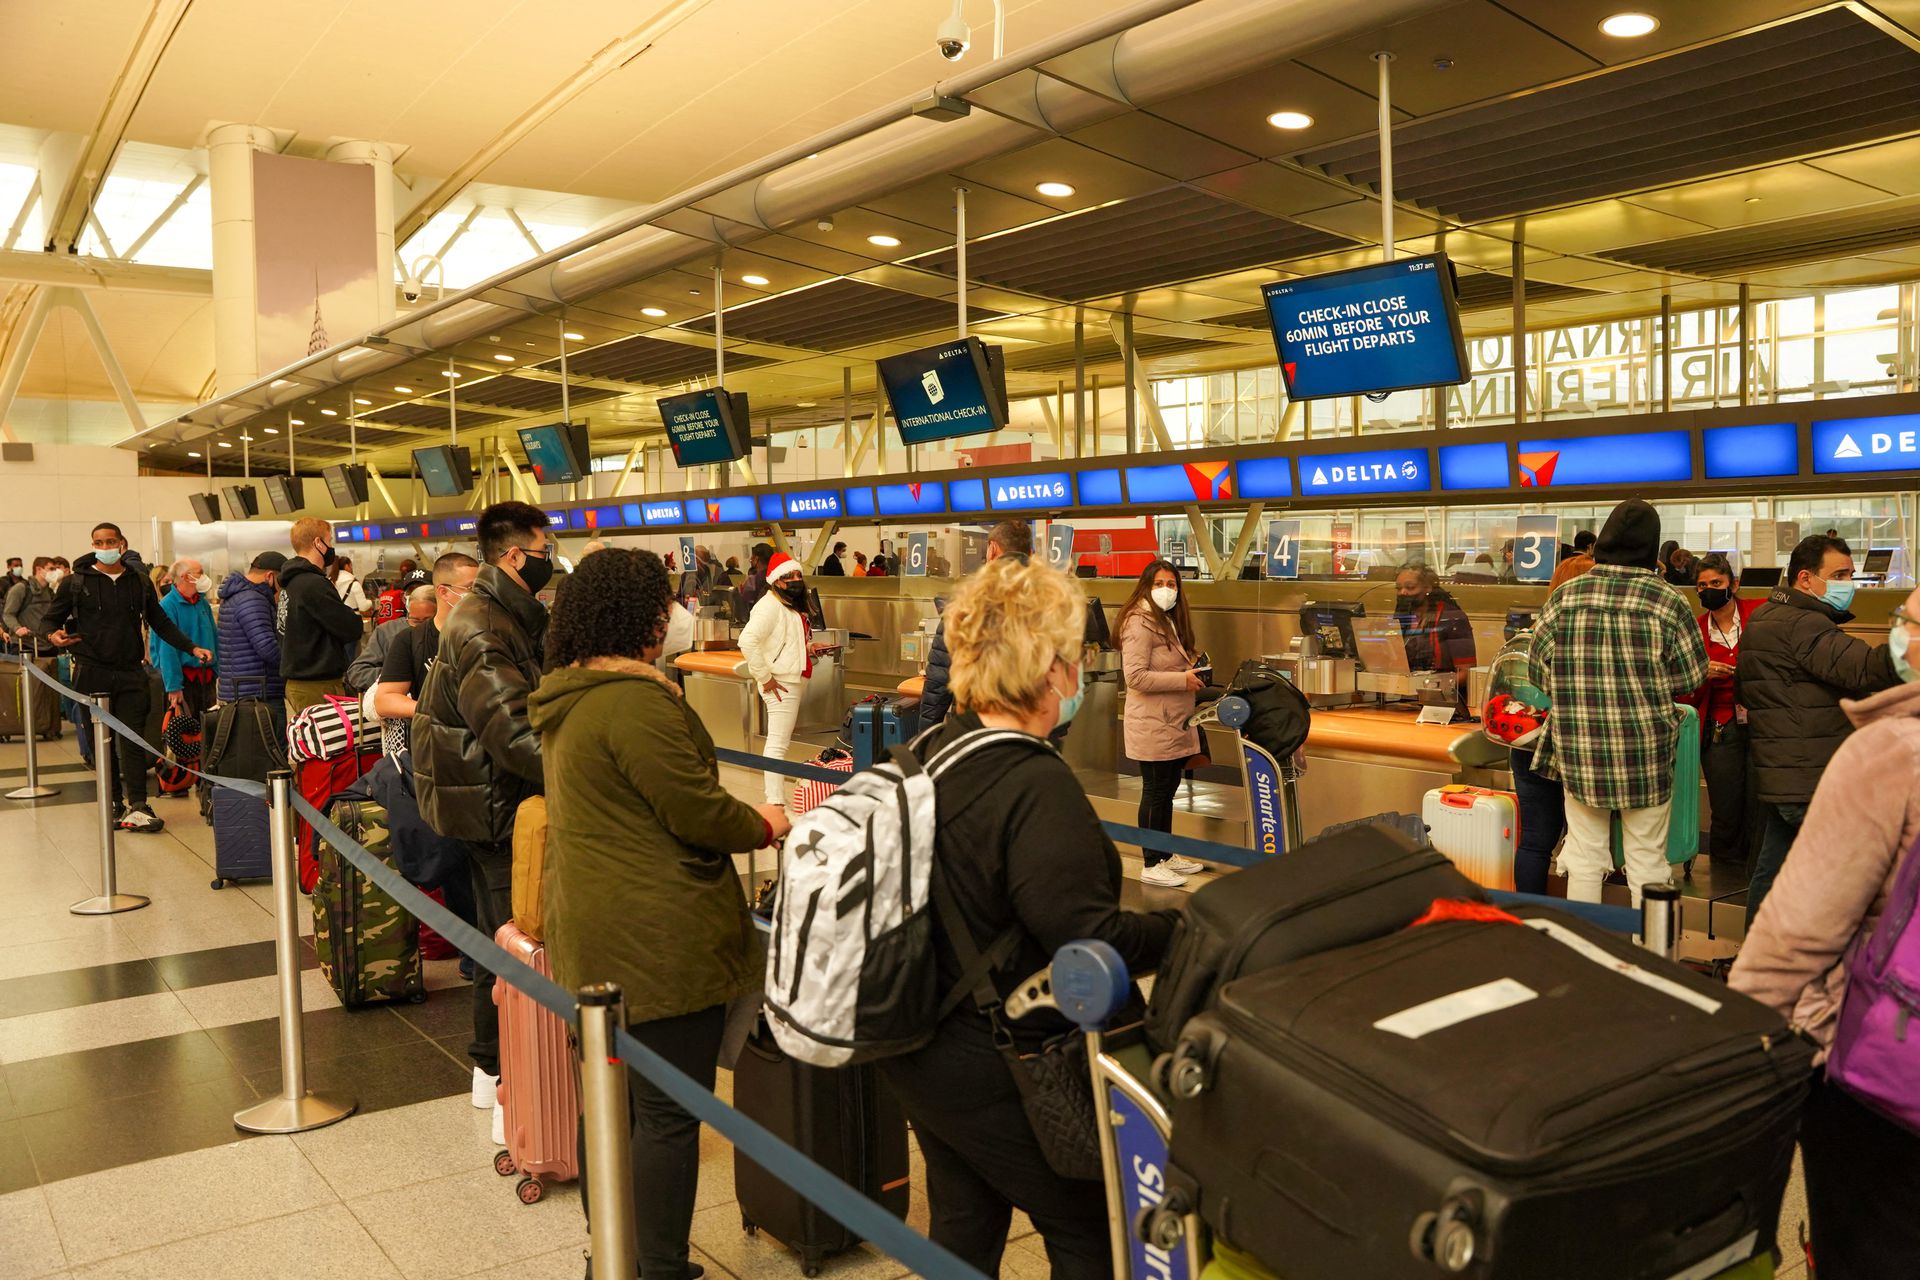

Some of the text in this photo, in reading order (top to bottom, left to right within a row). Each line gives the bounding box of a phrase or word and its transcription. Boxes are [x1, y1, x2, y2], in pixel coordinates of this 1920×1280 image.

[1408, 262, 1423, 272] 11:37
[1271, 288, 1289, 296] DELTA
[1298, 296, 1407, 324] CHECK-IN CLOSE
[1286, 310, 1430, 343] 60MIN BEFORE YOUR
[943, 348, 963, 358] DELTA
[1305, 330, 1416, 356] FLIGHT DEPARTS
[671, 419, 720, 433] 60MIN BEFORE YOUR
[673, 410, 711, 424] CHECK-IN CLOSE
[901, 405, 987, 428] INTERNATIONAL CHECK-IN
[679, 429, 717, 442] FLIGHT DEPARTS
[1331, 463, 1398, 483] DELTA
[1008, 484, 1052, 500] DELTA
[652, 507, 674, 519] DELTA
[798, 498, 828, 511] DELTA
[683, 545, 691, 565] 8
[911, 543, 922, 568] 6
[1049, 536, 1062, 563] 5
[1273, 535, 1291, 567] 4
[1520, 531, 1542, 570] 3
[1255, 771, 1278, 854] smarteca
